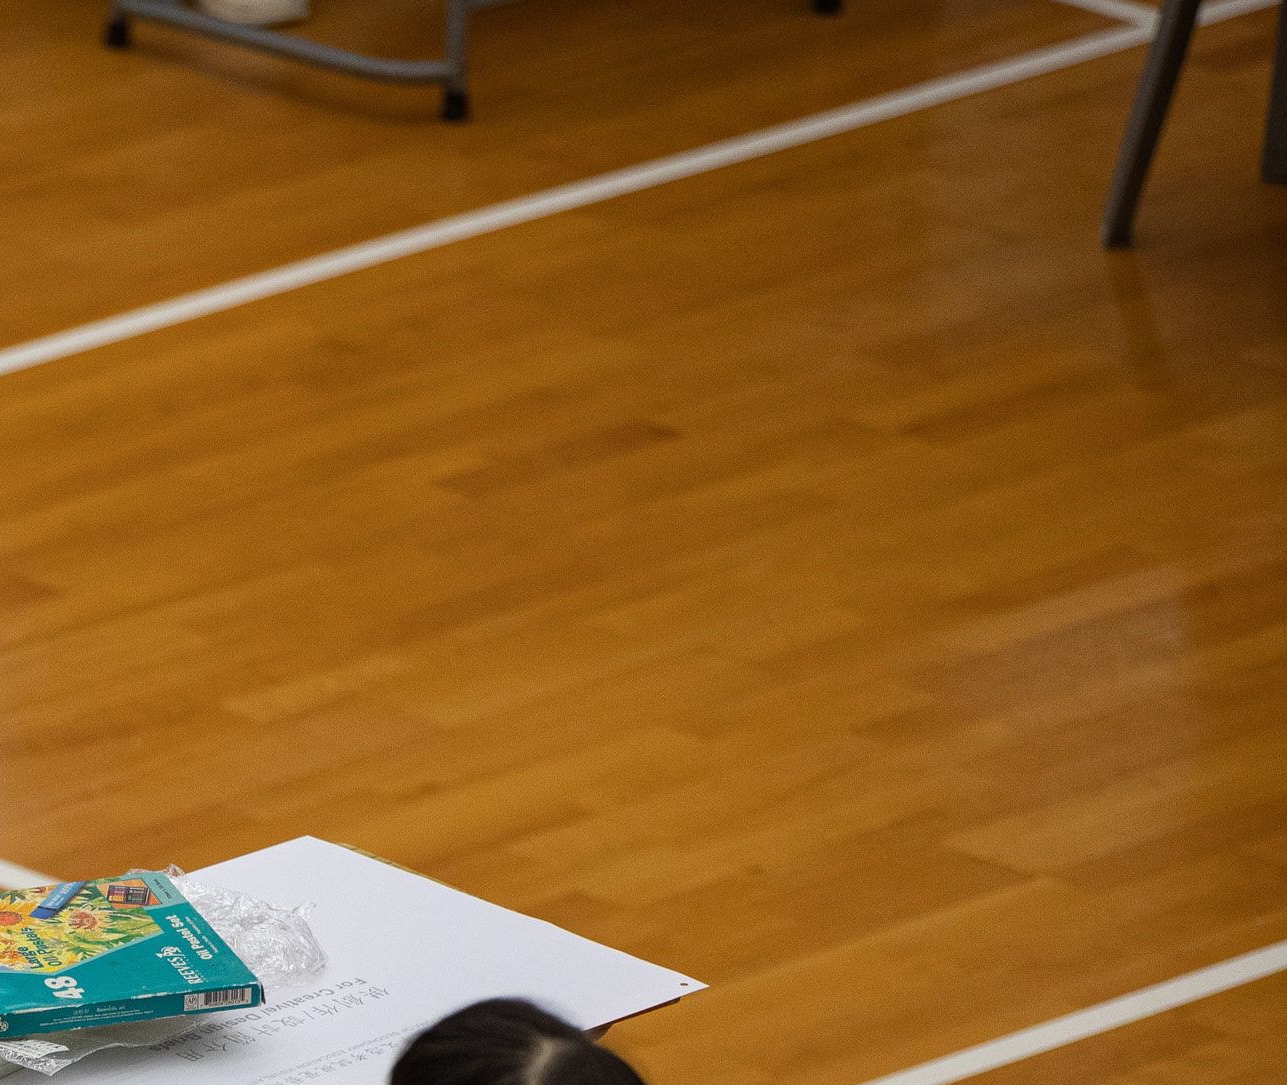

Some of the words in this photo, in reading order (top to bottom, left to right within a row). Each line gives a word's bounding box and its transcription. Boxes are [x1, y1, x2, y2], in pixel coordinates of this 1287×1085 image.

[165, 914, 184, 928] Set
[21, 927, 53, 954] Pastels
[176, 928, 205, 950] Pastel
[18, 946, 44, 969] Large
[43, 956, 63, 967] Oil
[196, 949, 213, 960] Oil
[167, 956, 204, 985] REEVES
[43, 975, 85, 999] 48
[335, 977, 367, 990] For
[200, 1013, 262, 1034] Design
